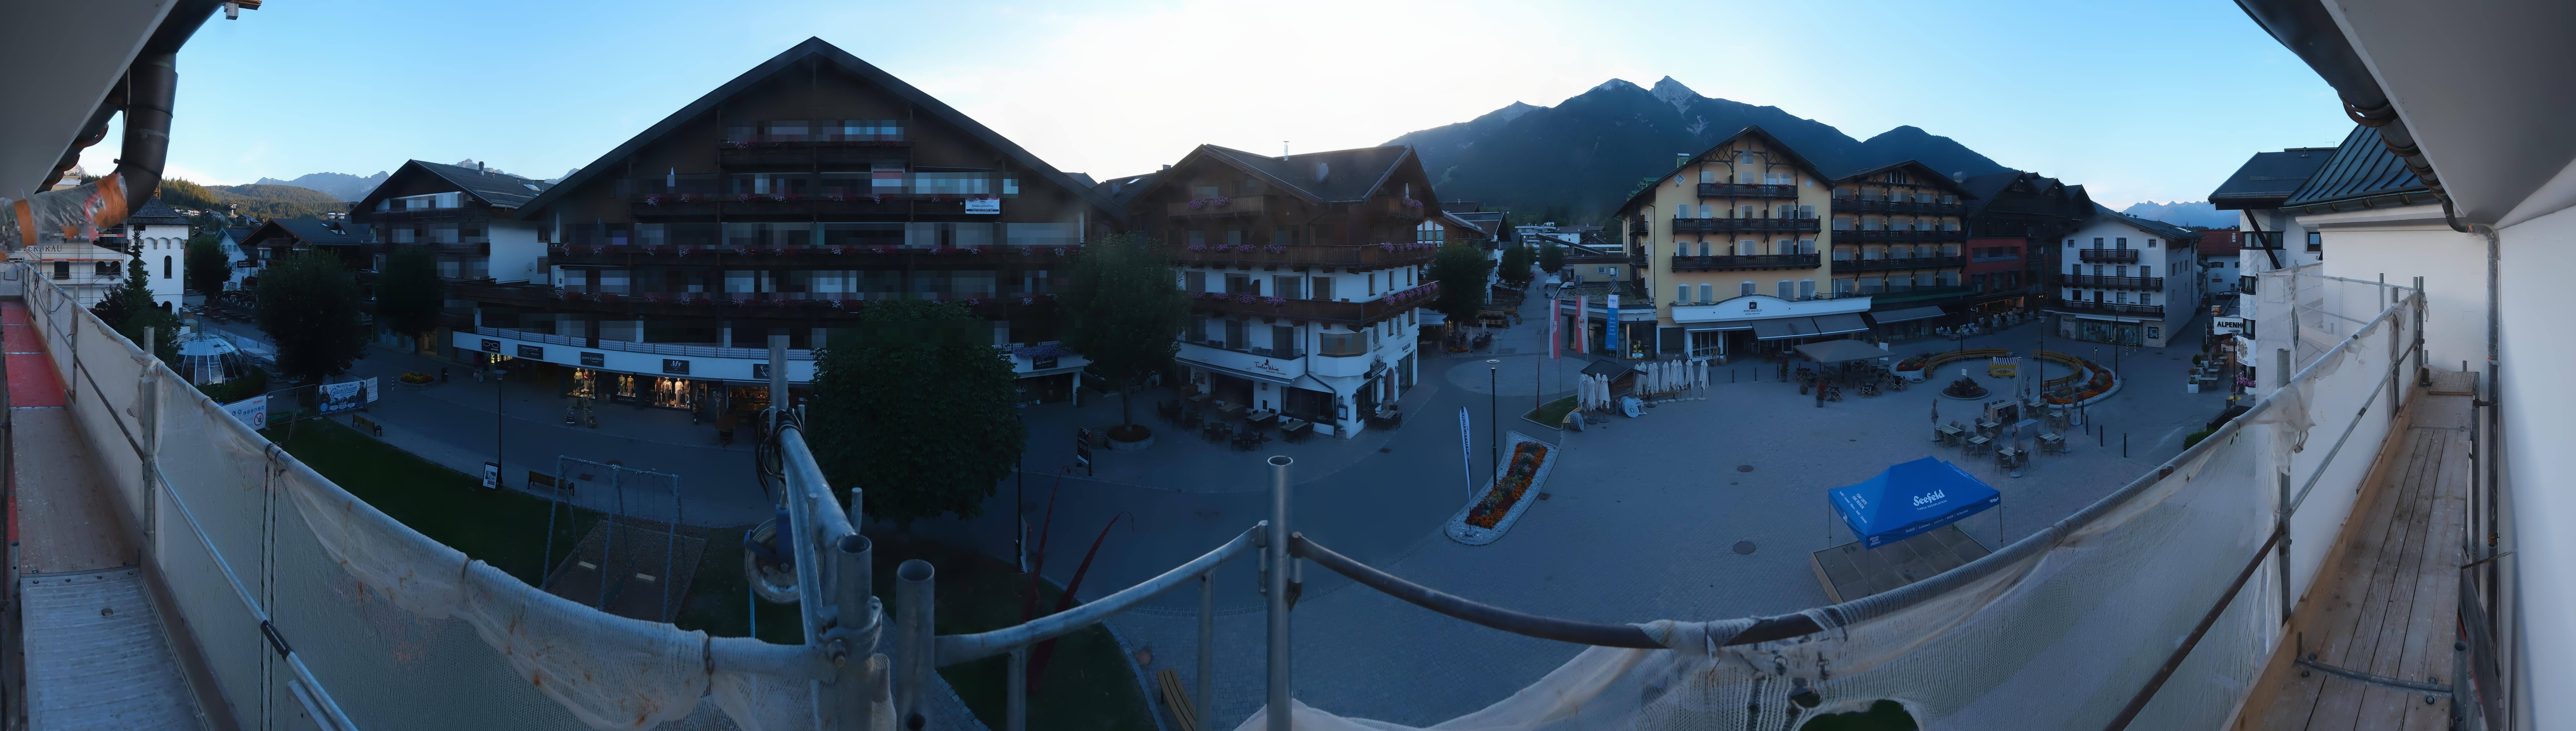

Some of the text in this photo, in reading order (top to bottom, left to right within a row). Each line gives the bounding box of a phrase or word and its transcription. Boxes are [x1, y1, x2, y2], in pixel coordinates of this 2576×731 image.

[1402, 343, 1411, 352] SAILER
[671, 360, 682, 370] My
[1372, 364, 1386, 377] RESTAURANT
[330, 386, 357, 399] Glanzbuam
[1913, 489, 1945, 506] Seefeld
[1856, 500, 1865, 509] REGION
[1927, 499, 1947, 508] HOCHPLATEAU
